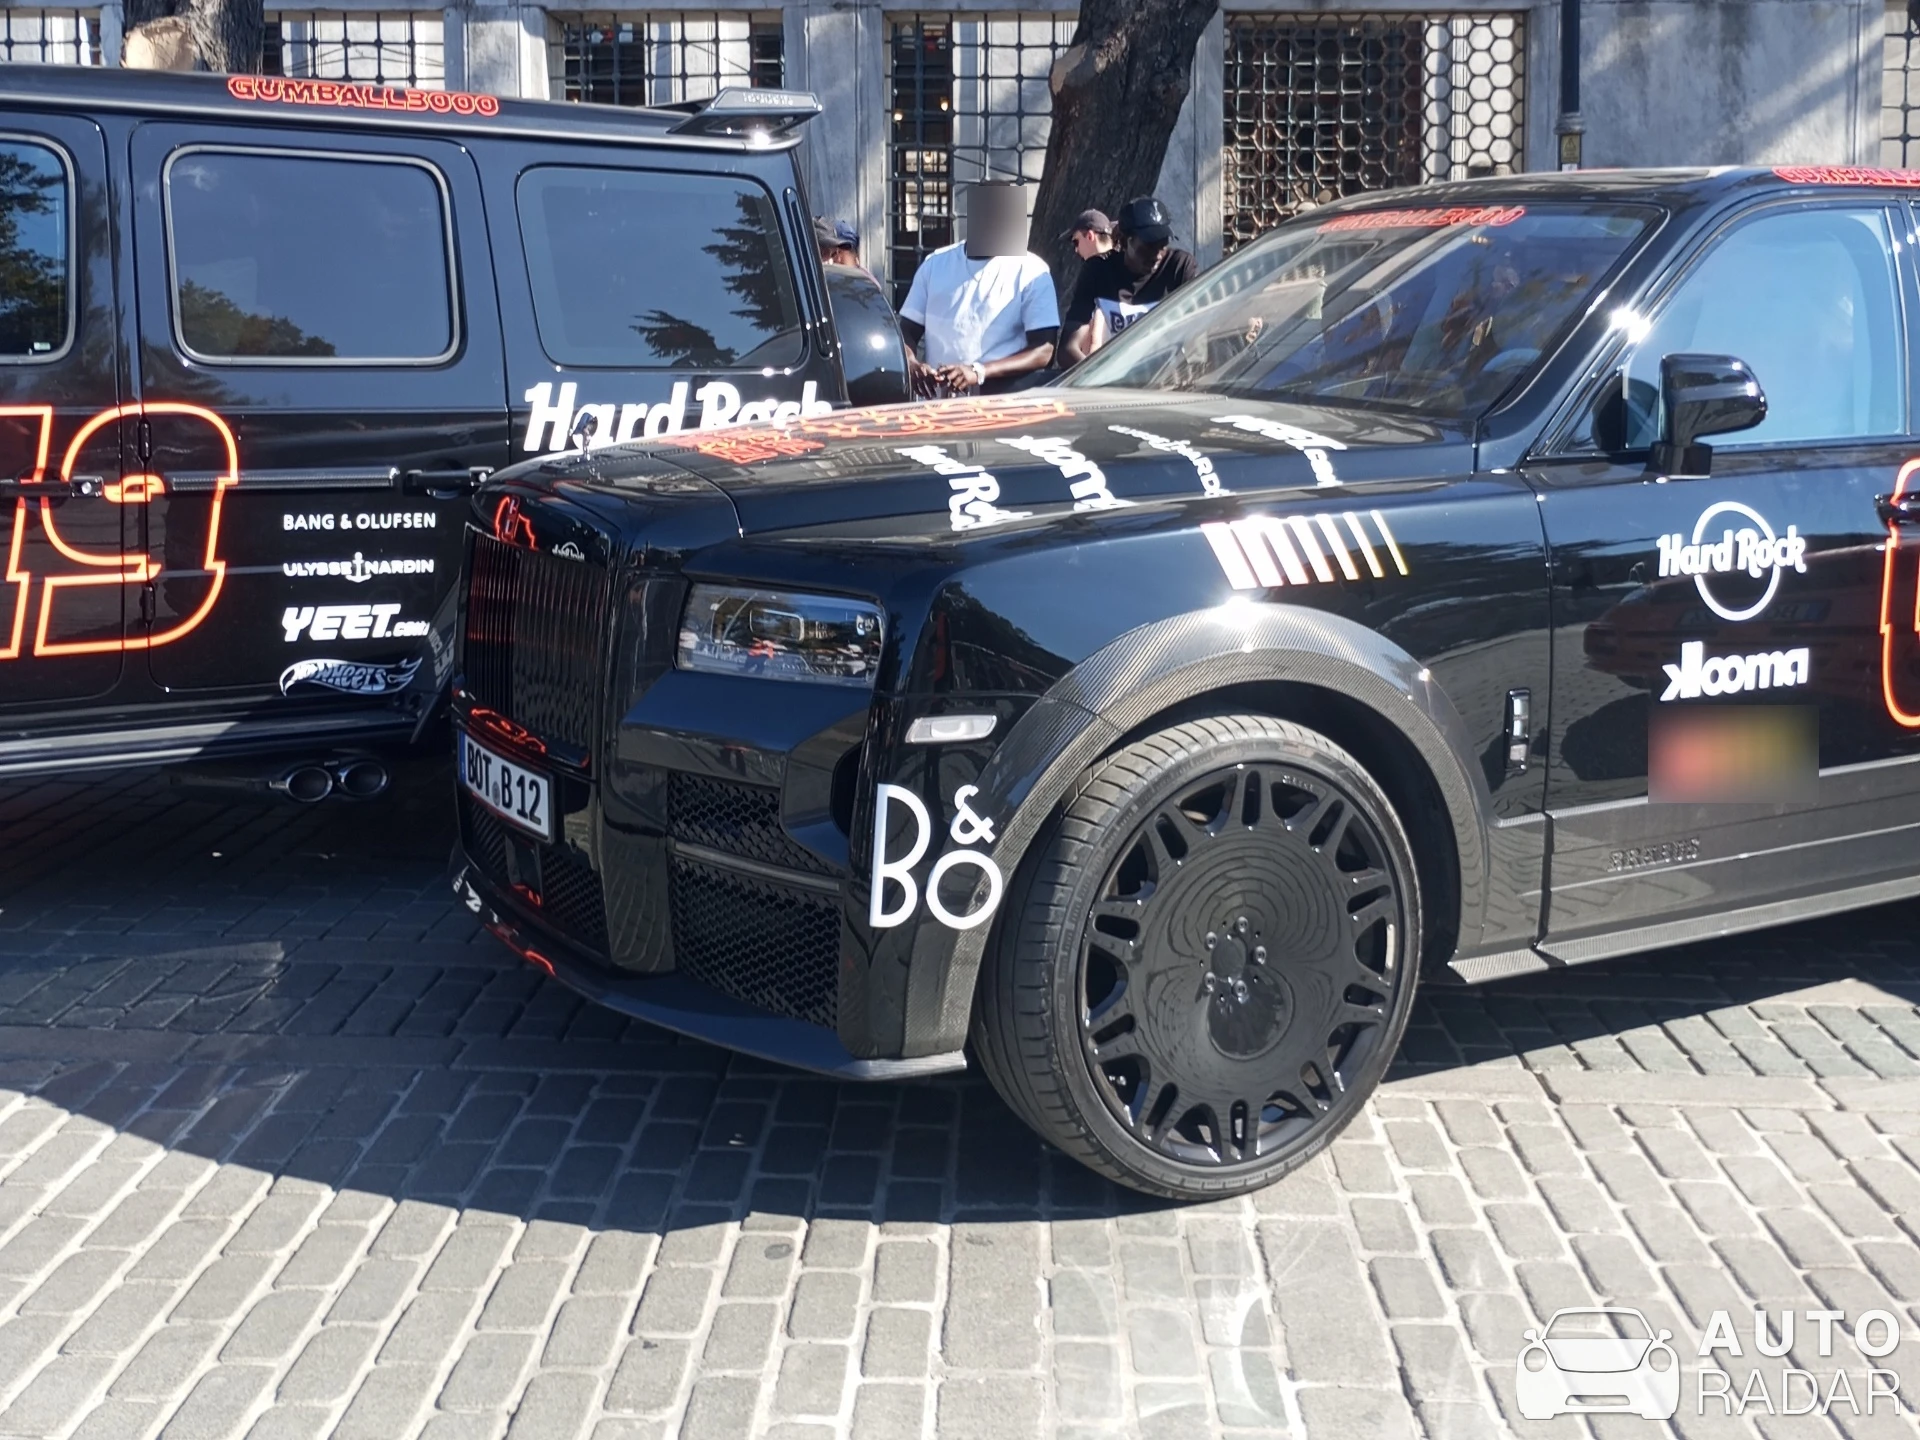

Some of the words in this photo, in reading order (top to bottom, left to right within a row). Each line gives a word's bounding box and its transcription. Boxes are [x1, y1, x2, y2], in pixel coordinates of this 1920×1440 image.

[228, 76, 500, 117] GUMBALL3000
[523, 381, 688, 451] Hard
[283, 514, 335, 531] BANG
[340, 514, 353, 530] &
[356, 512, 436, 530] OLUFSEN
[283, 561, 353, 577] ULYSSE
[365, 559, 435, 575] NARDIN
[1656, 529, 1733, 577] Hard
[1735, 525, 1807, 578] Rock
[467, 741, 492, 797] BOT
